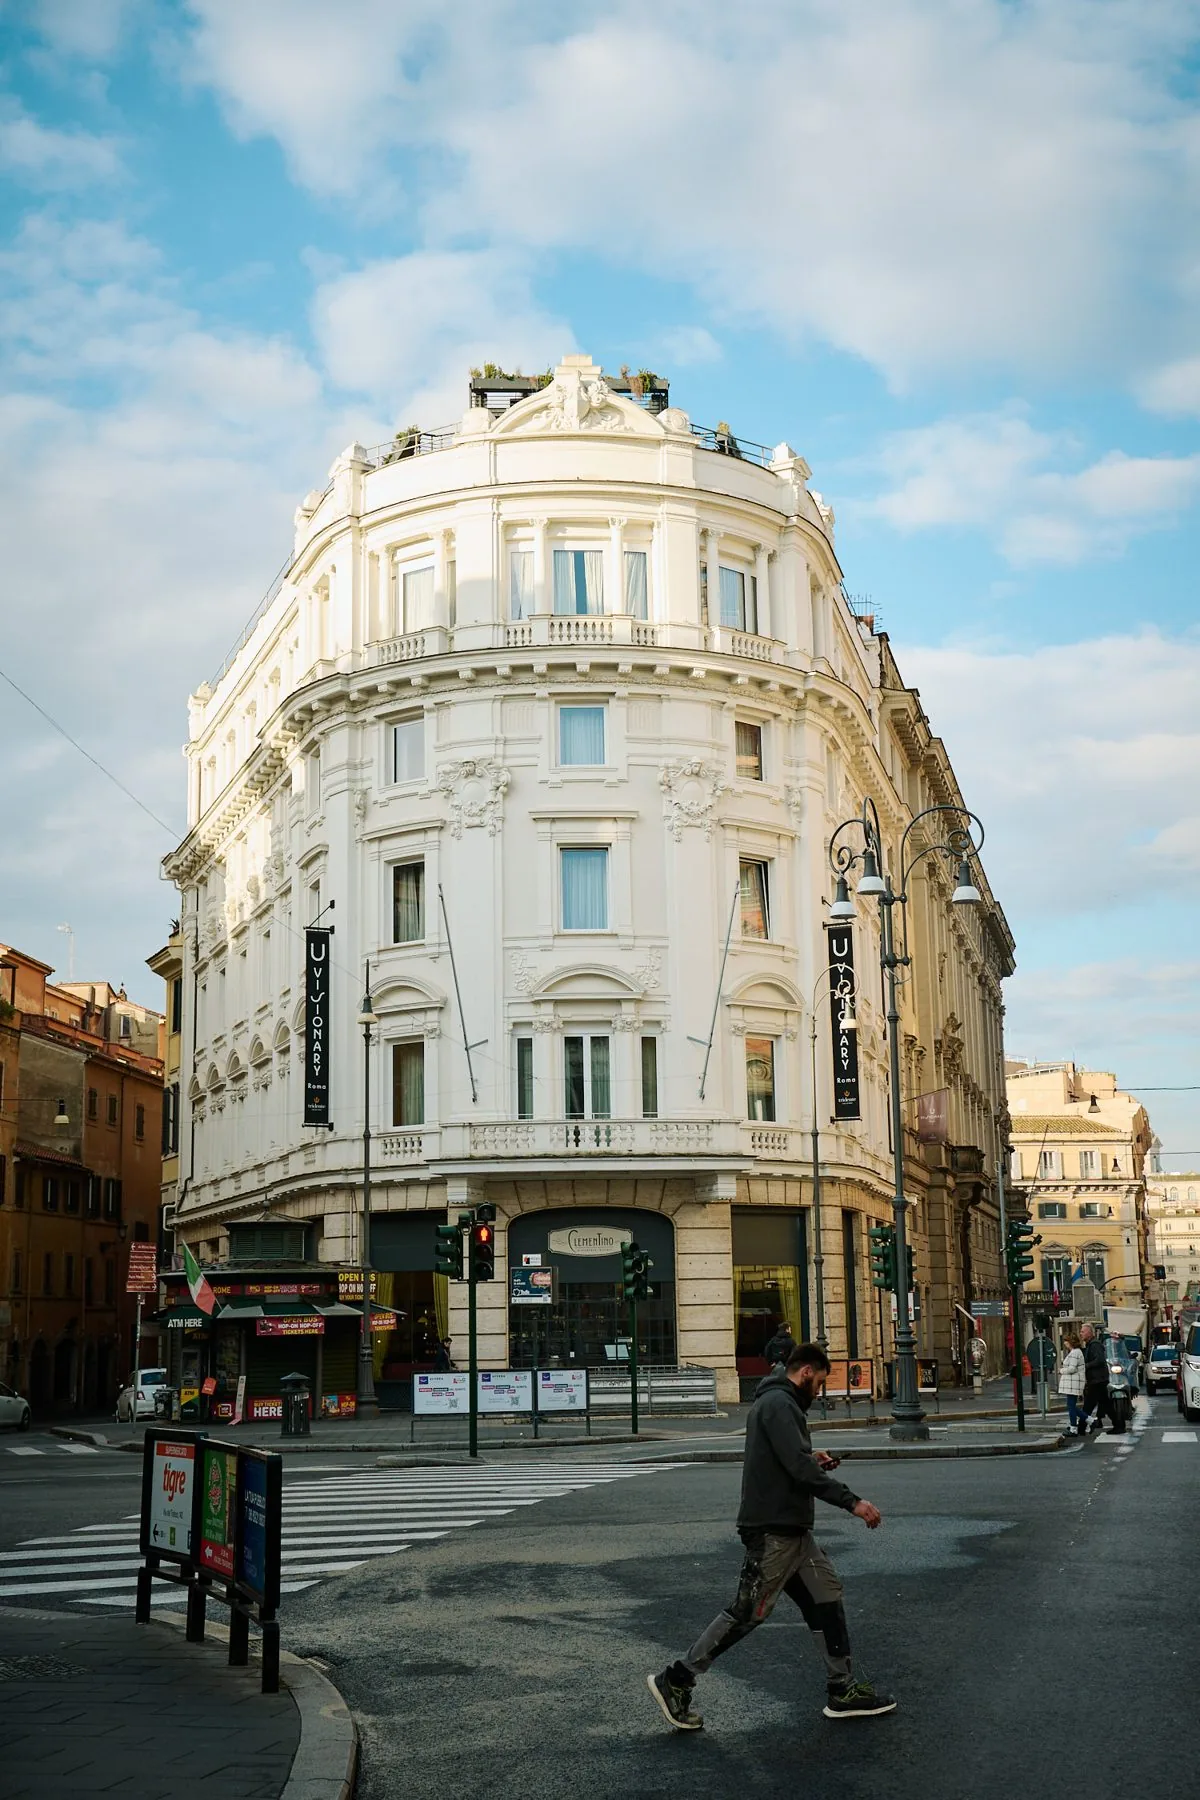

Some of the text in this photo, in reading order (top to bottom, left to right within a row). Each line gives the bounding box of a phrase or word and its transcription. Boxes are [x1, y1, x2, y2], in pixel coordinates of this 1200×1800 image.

[307, 1082, 327, 1090] Roma
[338, 1273, 376, 1282] OPEN BS
[213, 1286, 231, 1294] ROME
[167, 1318, 203, 1328] ATM HERE
[253, 1406, 283, 1417] HERE
[163, 1462, 186, 1502] tigre
